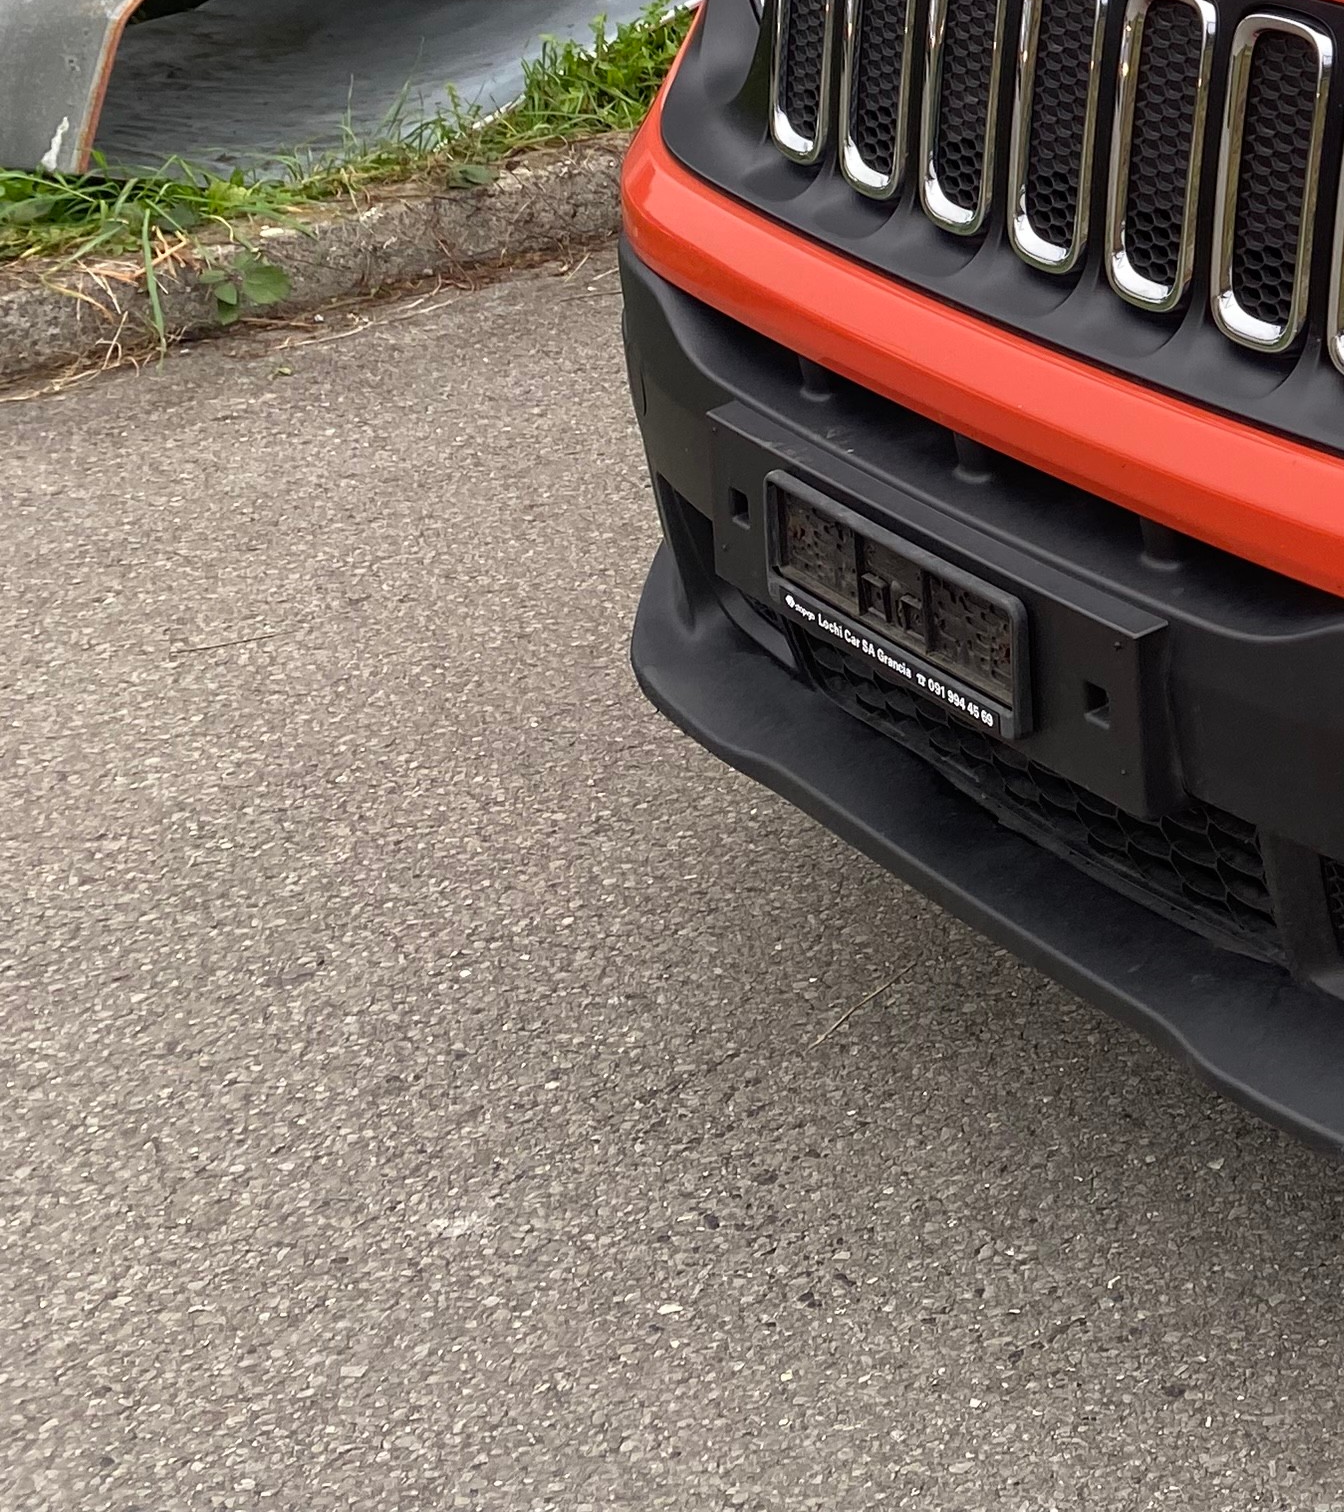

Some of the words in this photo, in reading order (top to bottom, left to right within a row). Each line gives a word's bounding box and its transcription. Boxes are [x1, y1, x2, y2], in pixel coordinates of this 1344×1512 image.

[817, 612, 844, 639] Lochi
[844, 628, 861, 648] Car
[861, 638, 876, 658] SA
[876, 648, 912, 679] Grancia
[927, 678, 946, 699] 091
[947, 689, 966, 711] 994
[966, 702, 980, 719] 45
